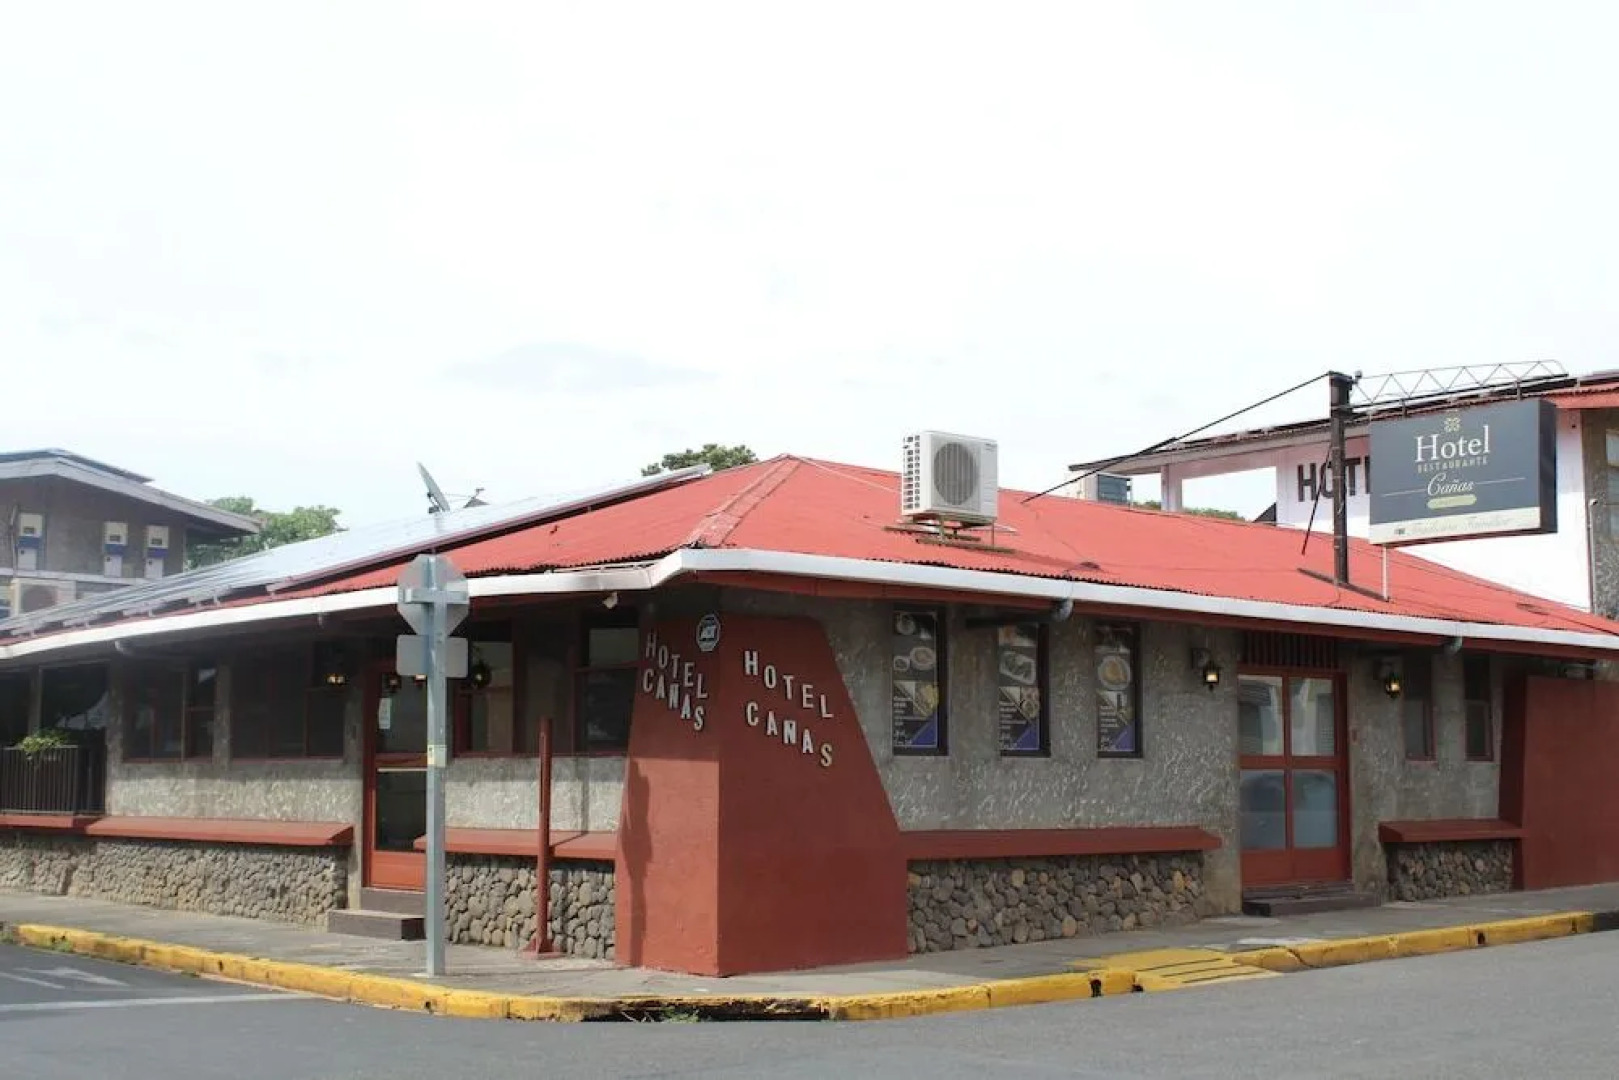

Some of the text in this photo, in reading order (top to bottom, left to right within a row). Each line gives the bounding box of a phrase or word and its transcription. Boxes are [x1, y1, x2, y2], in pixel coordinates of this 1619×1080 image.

[1415, 425, 1490, 462] Hotel
[1417, 456, 1488, 473] RESTAURANTE
[1298, 456, 1370, 502] HOT
[1428, 472, 1475, 496] Cañas
[645, 630, 708, 698] HOTEL
[744, 650, 834, 718] HOTEL
[643, 668, 703, 731] CANAS
[747, 702, 833, 767] CANAS
